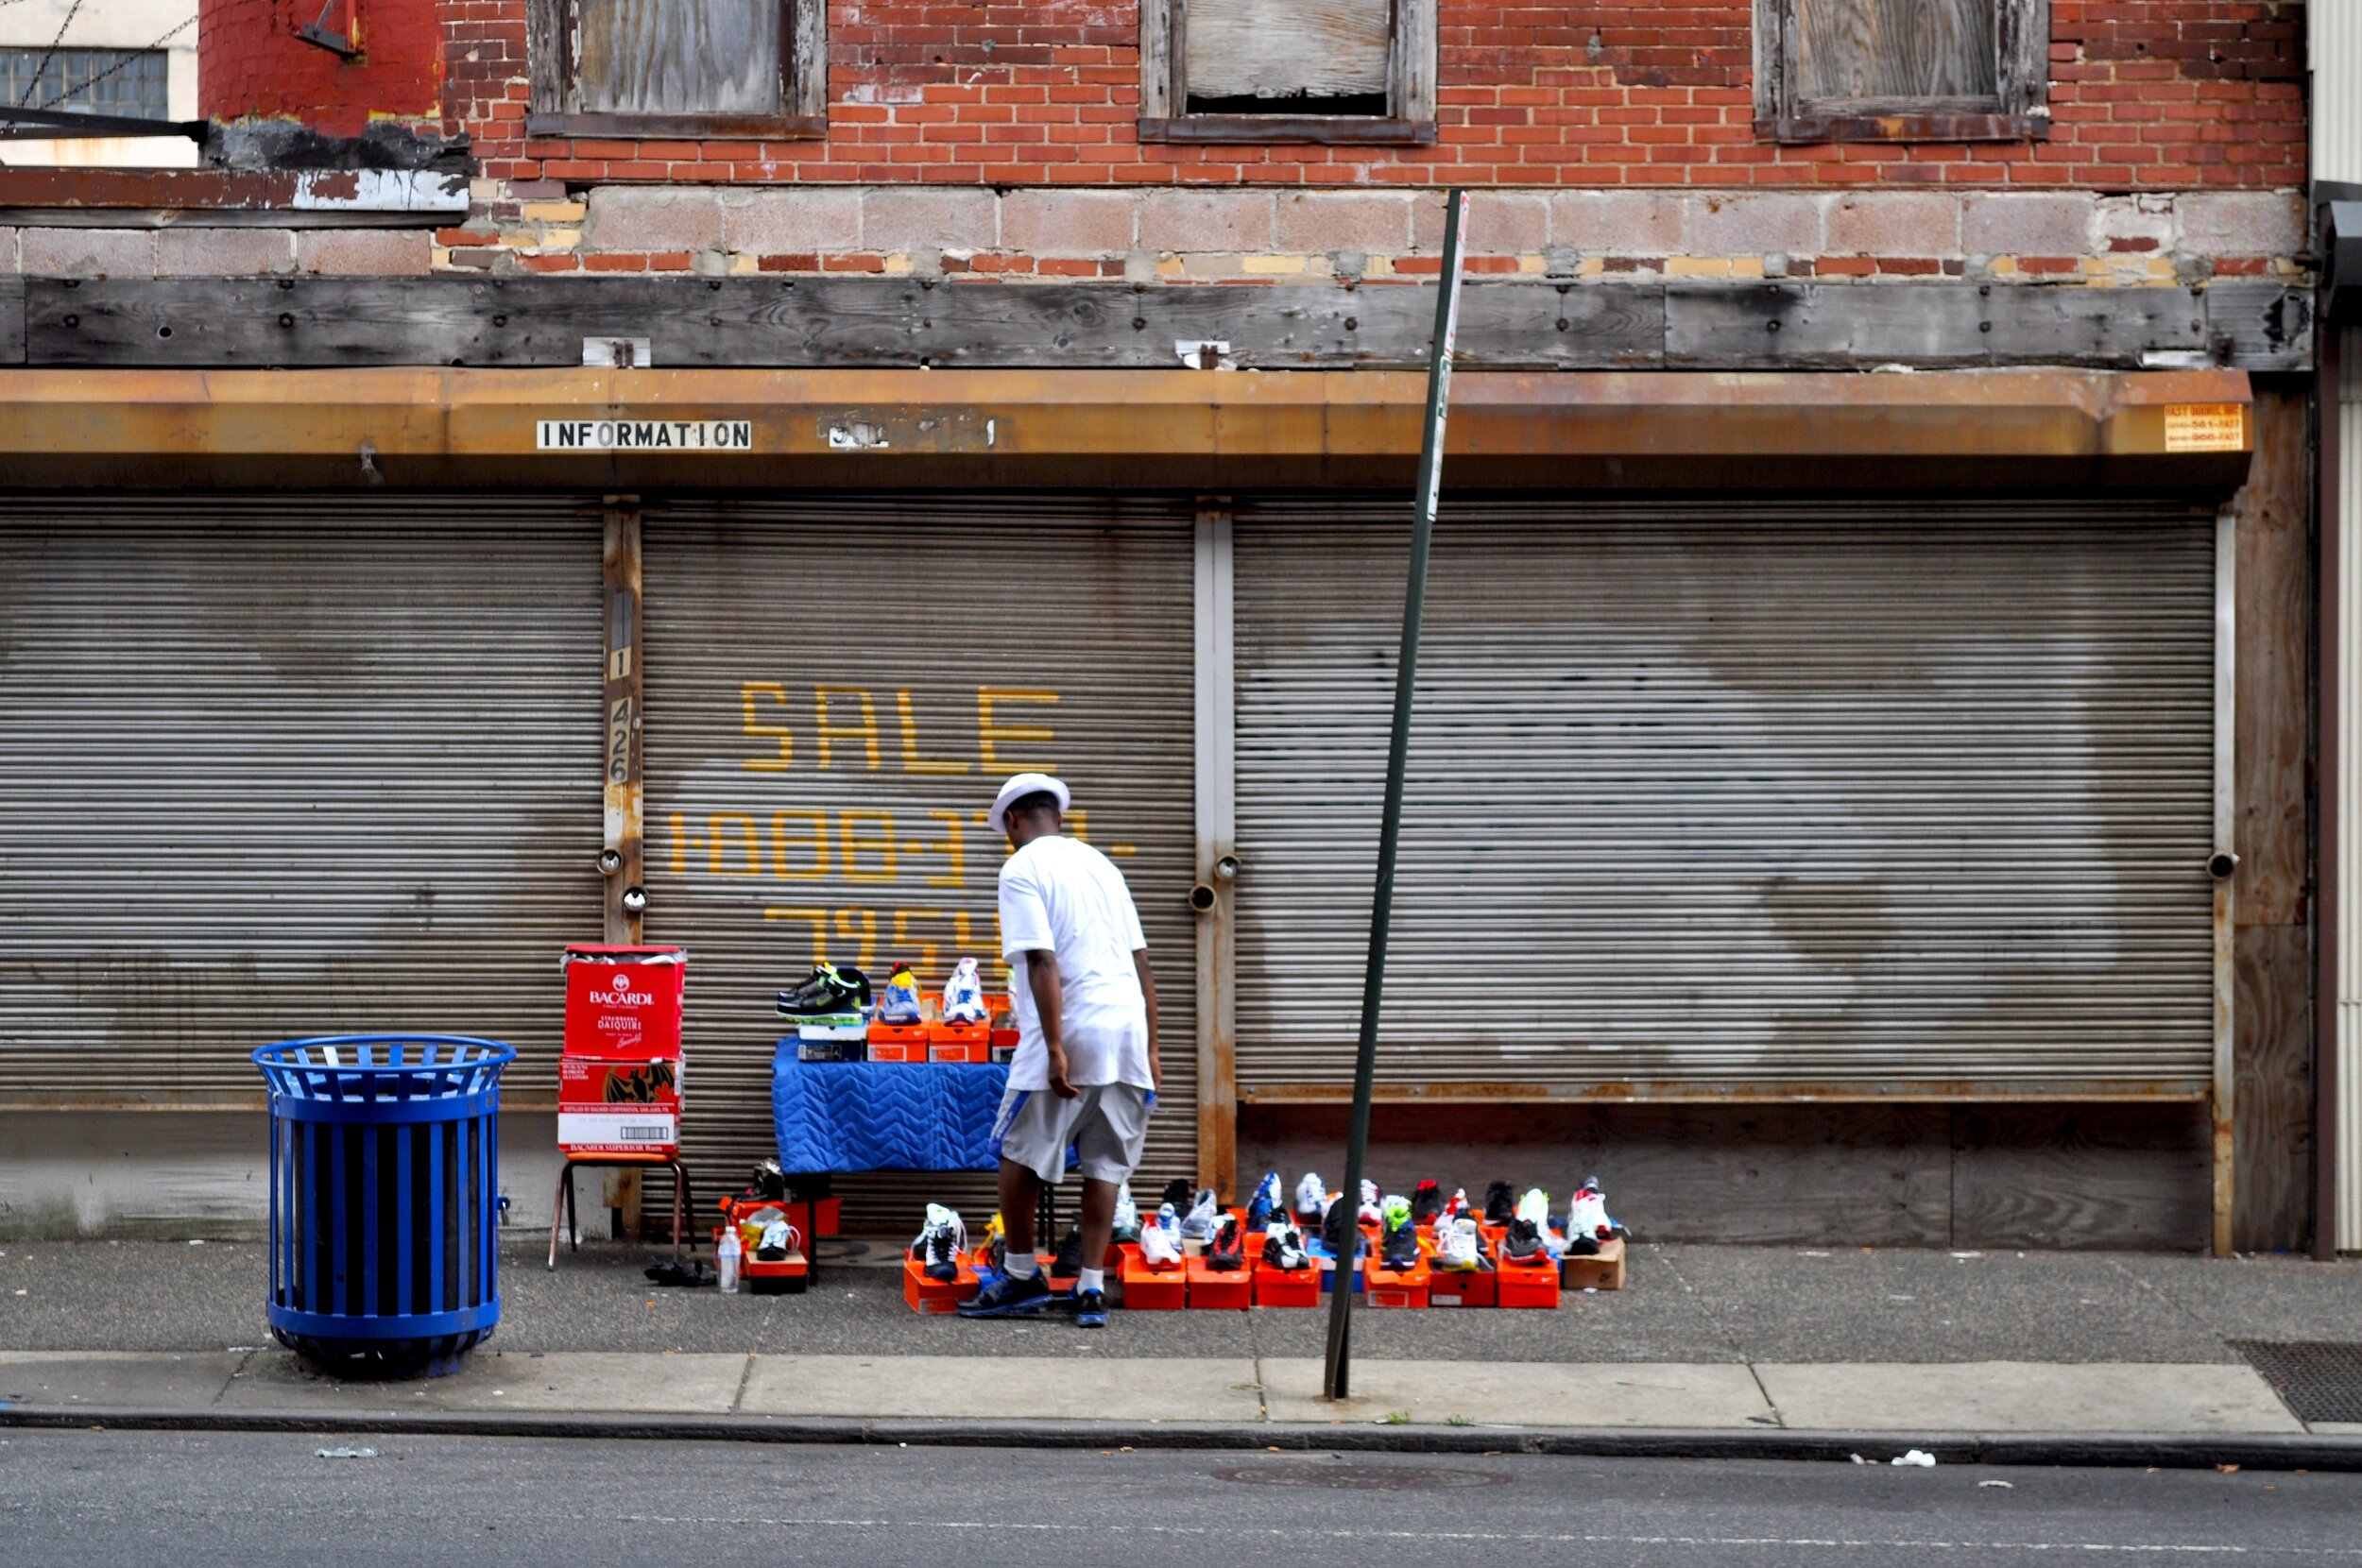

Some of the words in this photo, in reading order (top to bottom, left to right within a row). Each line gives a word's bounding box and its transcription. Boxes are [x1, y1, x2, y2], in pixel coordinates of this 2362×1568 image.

[543, 422, 749, 447] INFORMATION
[741, 681, 1060, 774] SALE
[668, 809, 1137, 887] 1-888-3-
[590, 991, 653, 1005] BACARDI
[597, 1019, 642, 1031] DAIQUIRI
